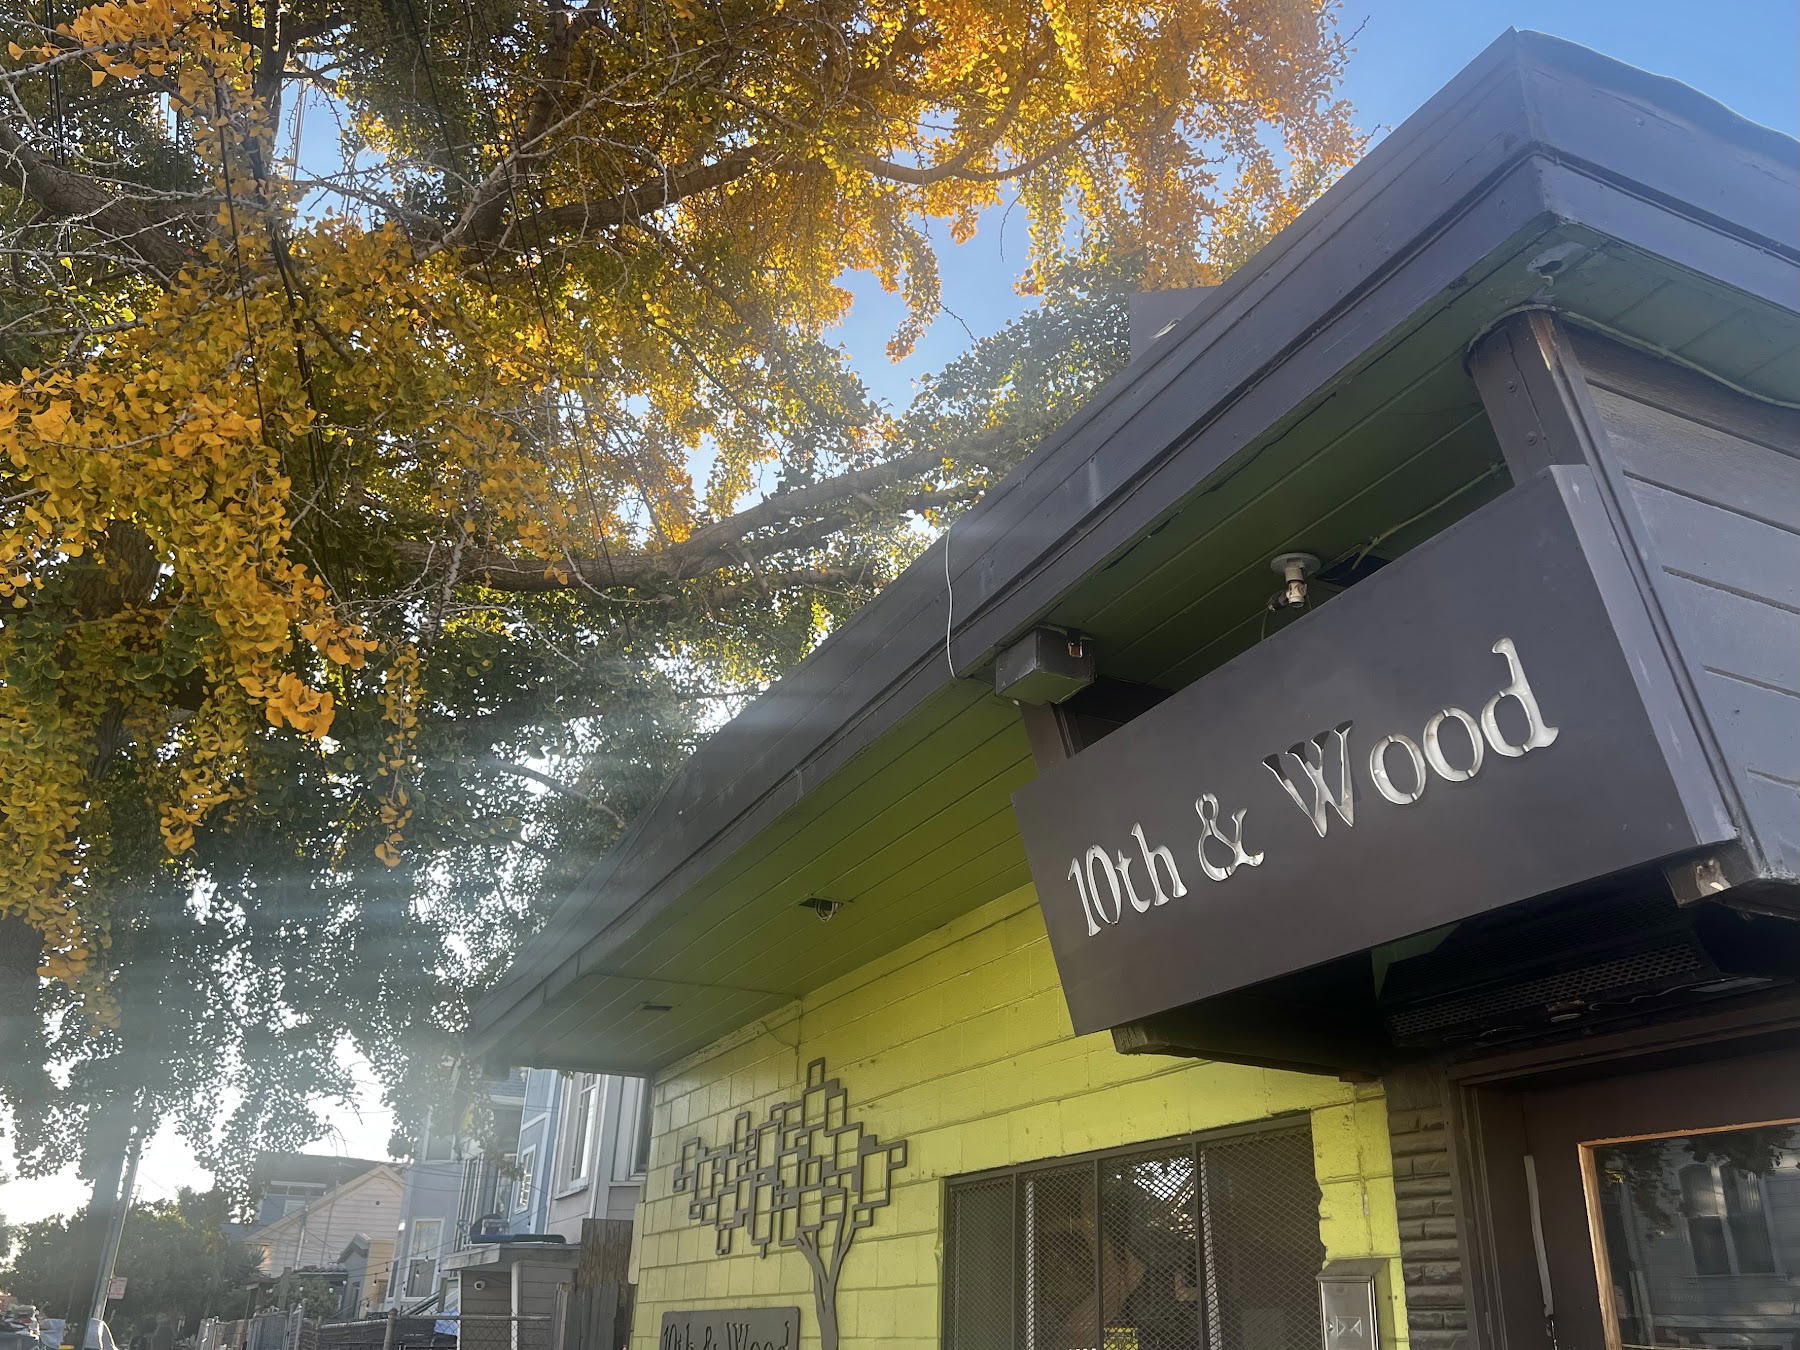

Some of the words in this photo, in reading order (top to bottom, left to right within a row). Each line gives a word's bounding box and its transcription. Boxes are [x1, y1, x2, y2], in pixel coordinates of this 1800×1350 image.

[1067, 822, 1187, 937] 10th
[1196, 792, 1264, 882] &
[1262, 637, 1559, 838] Wood
